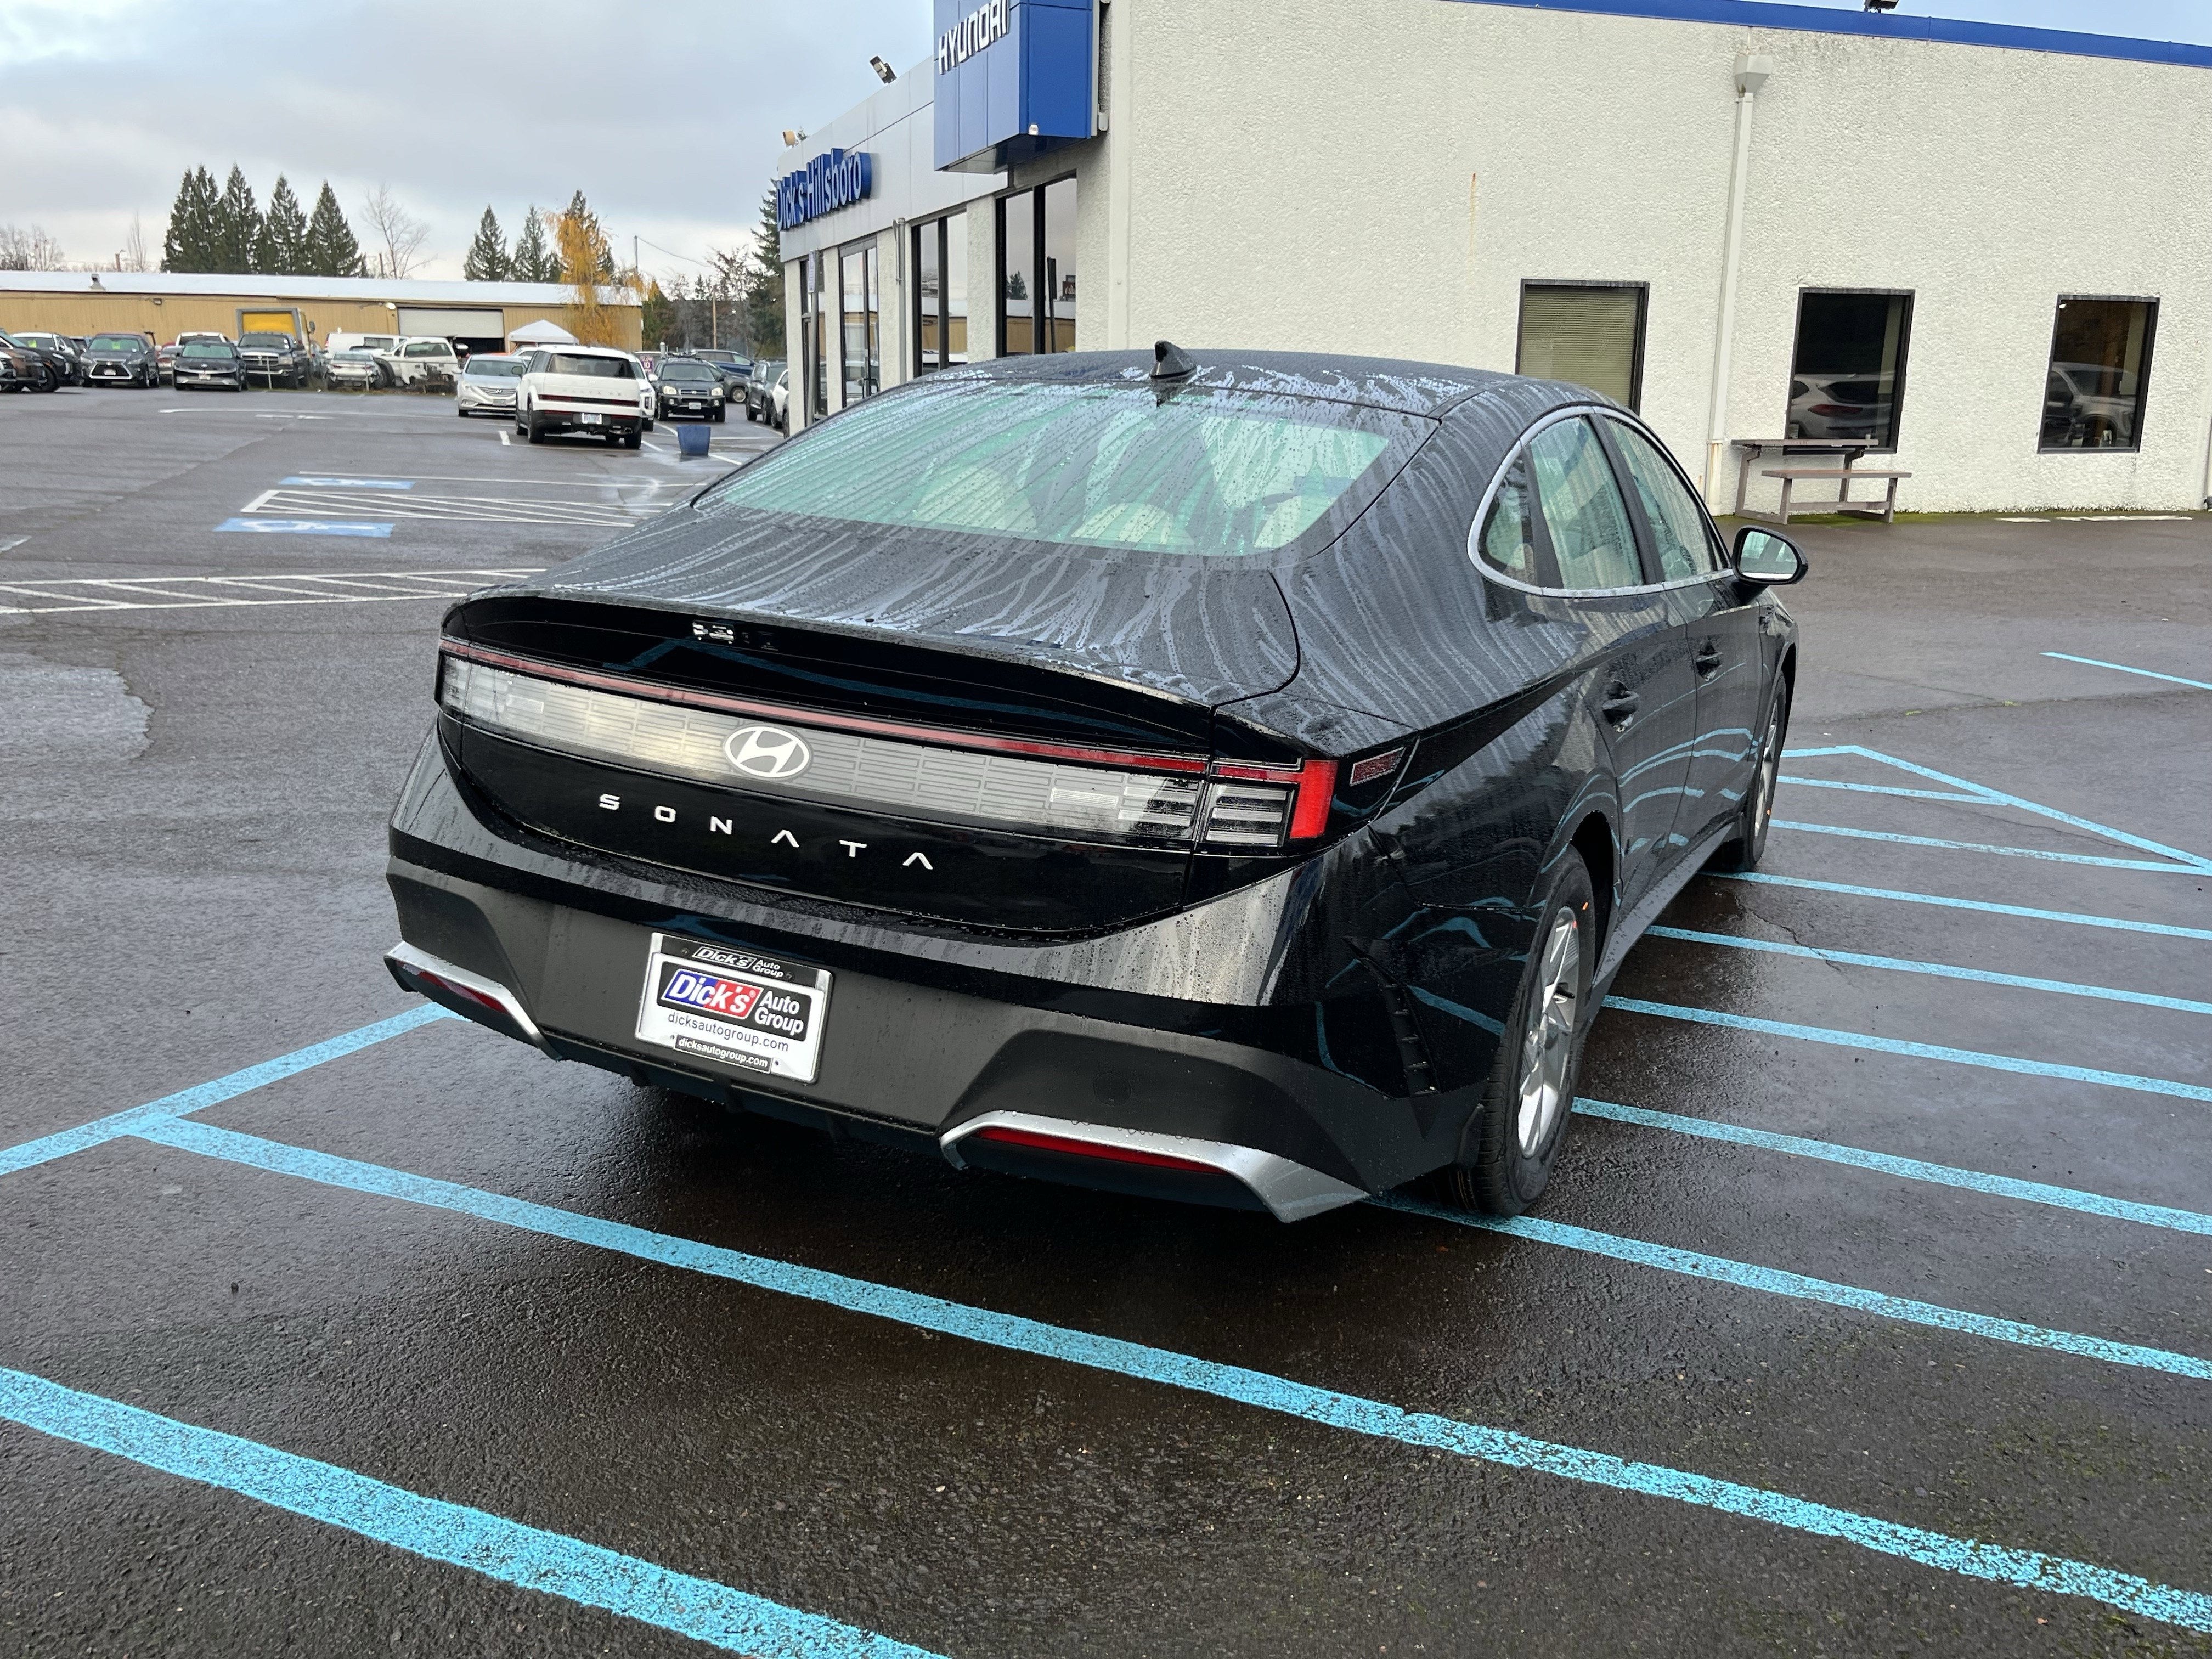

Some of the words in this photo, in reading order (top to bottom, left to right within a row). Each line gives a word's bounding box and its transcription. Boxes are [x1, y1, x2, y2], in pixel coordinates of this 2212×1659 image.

[938, 0, 1007, 75] HYUNDAI
[776, 171, 805, 232] Dick's
[806, 148, 862, 219] Hillsboro
[599, 793, 934, 870] SONATA
[697, 948, 749, 967] Dick's
[757, 960, 781, 970] Auto
[752, 964, 784, 978] Group
[668, 973, 751, 1014] Dick's
[759, 990, 800, 1015] Auto
[668, 1012, 789, 1052] dicksautogroup.com
[754, 1006, 805, 1036] Group
[678, 1037, 769, 1068] dicksautogroup.com
